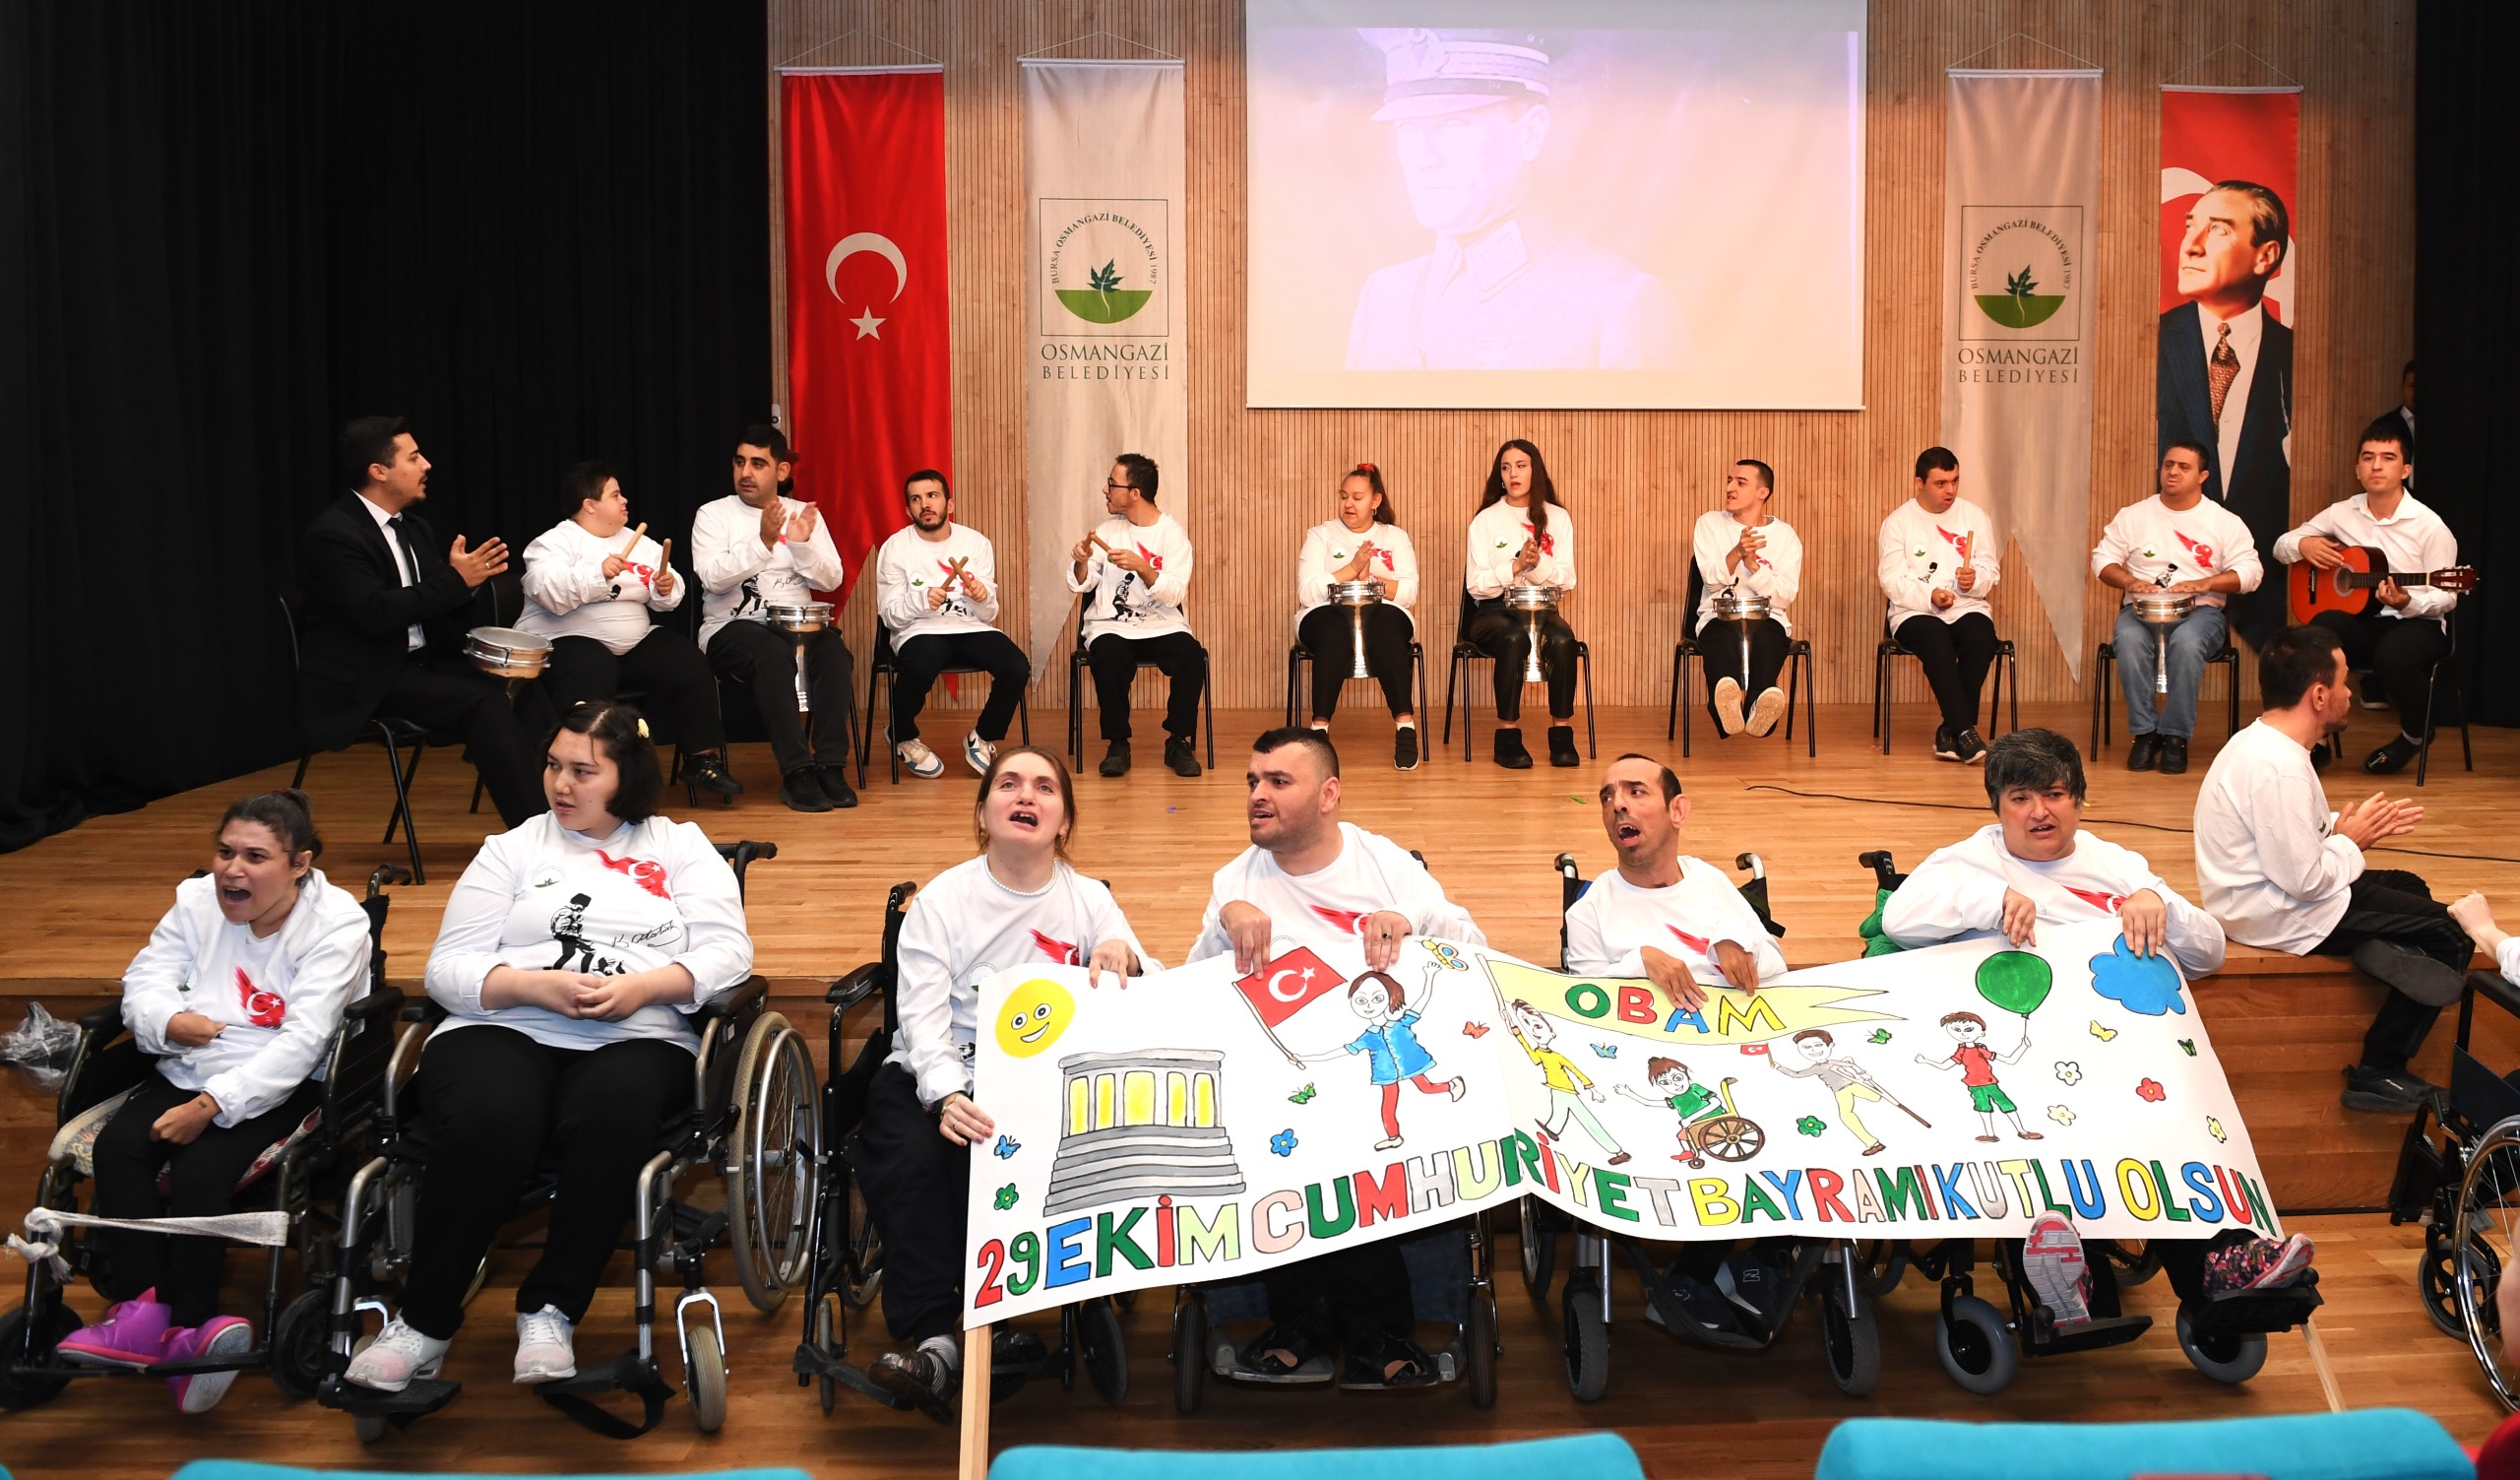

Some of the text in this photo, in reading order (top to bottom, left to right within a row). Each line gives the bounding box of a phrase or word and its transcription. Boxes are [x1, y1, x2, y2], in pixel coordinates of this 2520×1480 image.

[1050, 211, 1159, 285] BURSA OSMANGAZİ BELEDİYESİ 1987
[1970, 256, 1982, 290] BURSA
[1977, 218, 2028, 254] OSMANGAZİ
[2030, 220, 2071, 267] BELEDİYESİ
[1040, 343, 1169, 361] OSMANGAZİ
[1958, 347, 2078, 365] OSMANGAZİ
[1042, 365, 1169, 380] BELEDİYESİ
[1959, 368, 2078, 383] BELEDİYESİ
[1564, 983, 1787, 1036] OBAM
[1043, 1193, 1241, 1290] EKİM
[1251, 1127, 1681, 1254] CUMHURİYET
[1687, 1164, 1940, 1227] BAYRAMI
[1931, 1158, 2107, 1221] KUTLU
[2114, 1157, 2277, 1237] OLSUN
